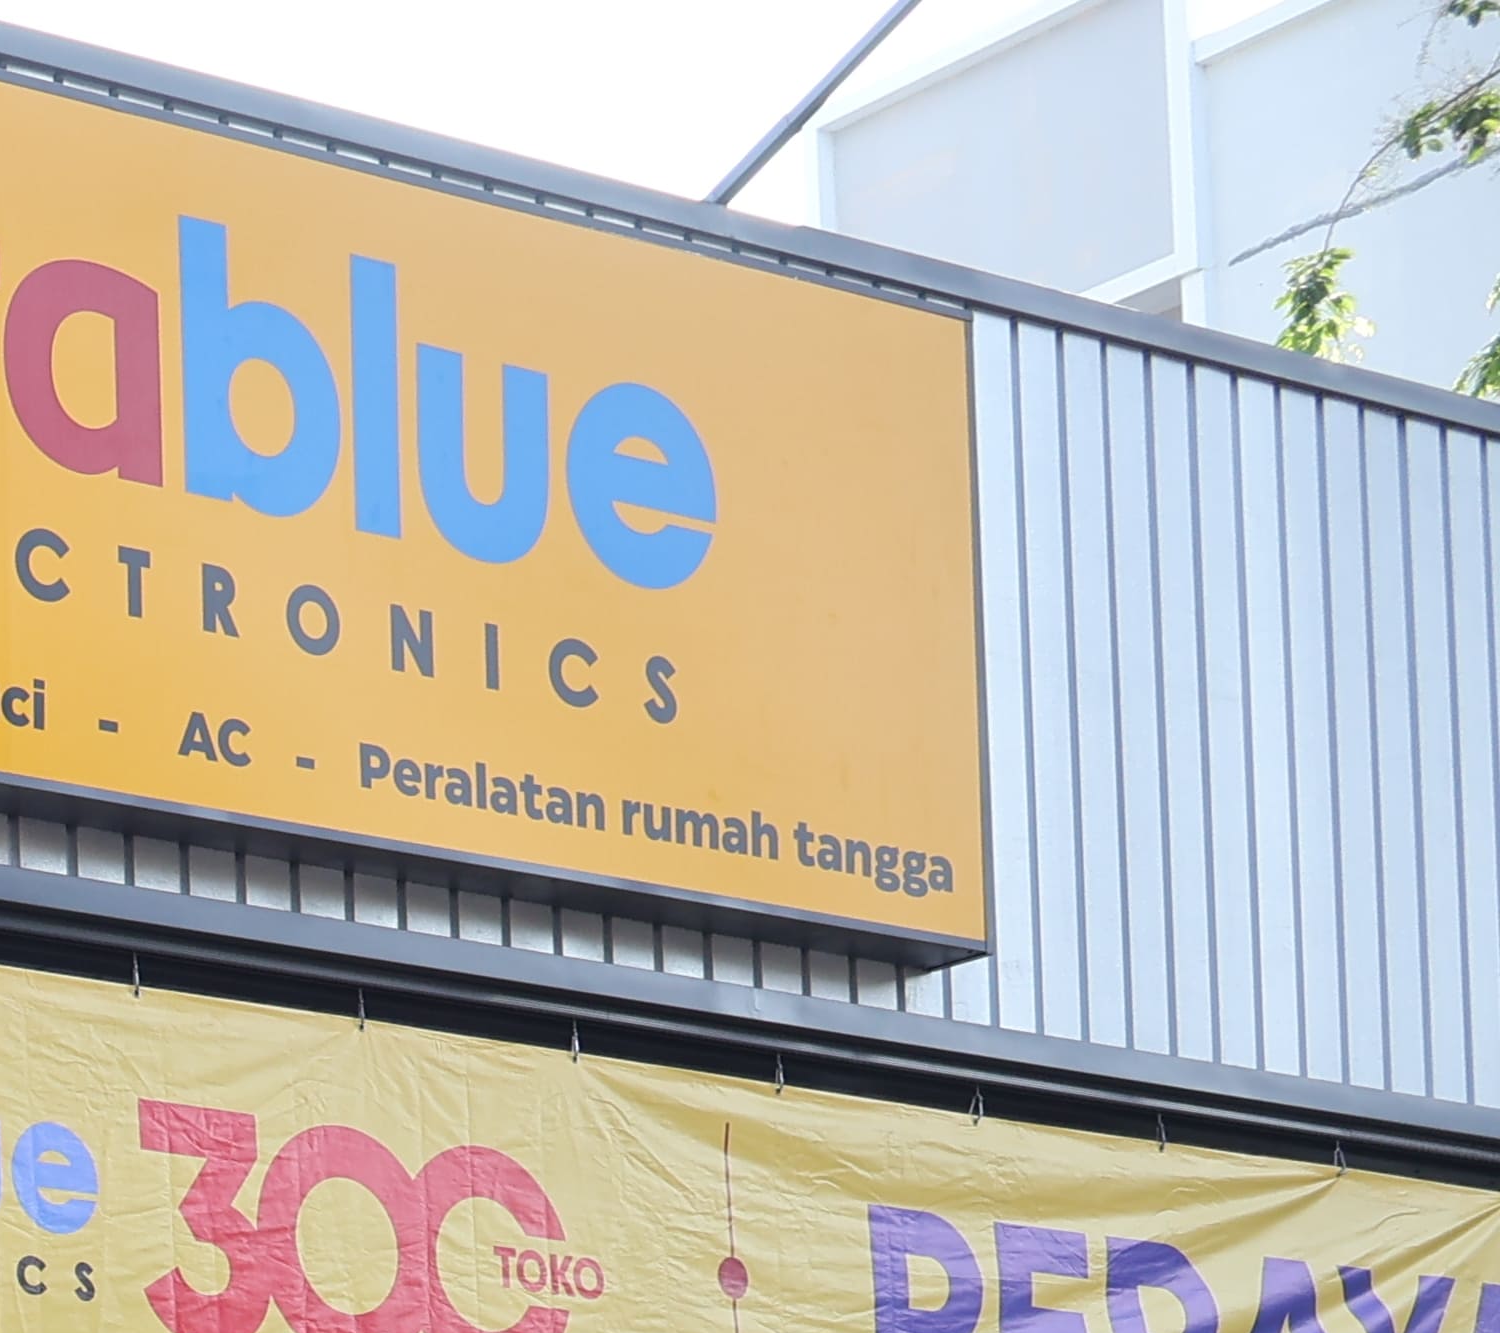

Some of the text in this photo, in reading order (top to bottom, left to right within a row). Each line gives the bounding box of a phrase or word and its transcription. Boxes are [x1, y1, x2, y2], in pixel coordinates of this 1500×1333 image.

[178, 711, 252, 767] AC
[359, 742, 606, 832] Peralatan
[620, 795, 779, 861] rumah
[793, 820, 953, 897] tangga
[493, 1244, 605, 1300] TOKO
